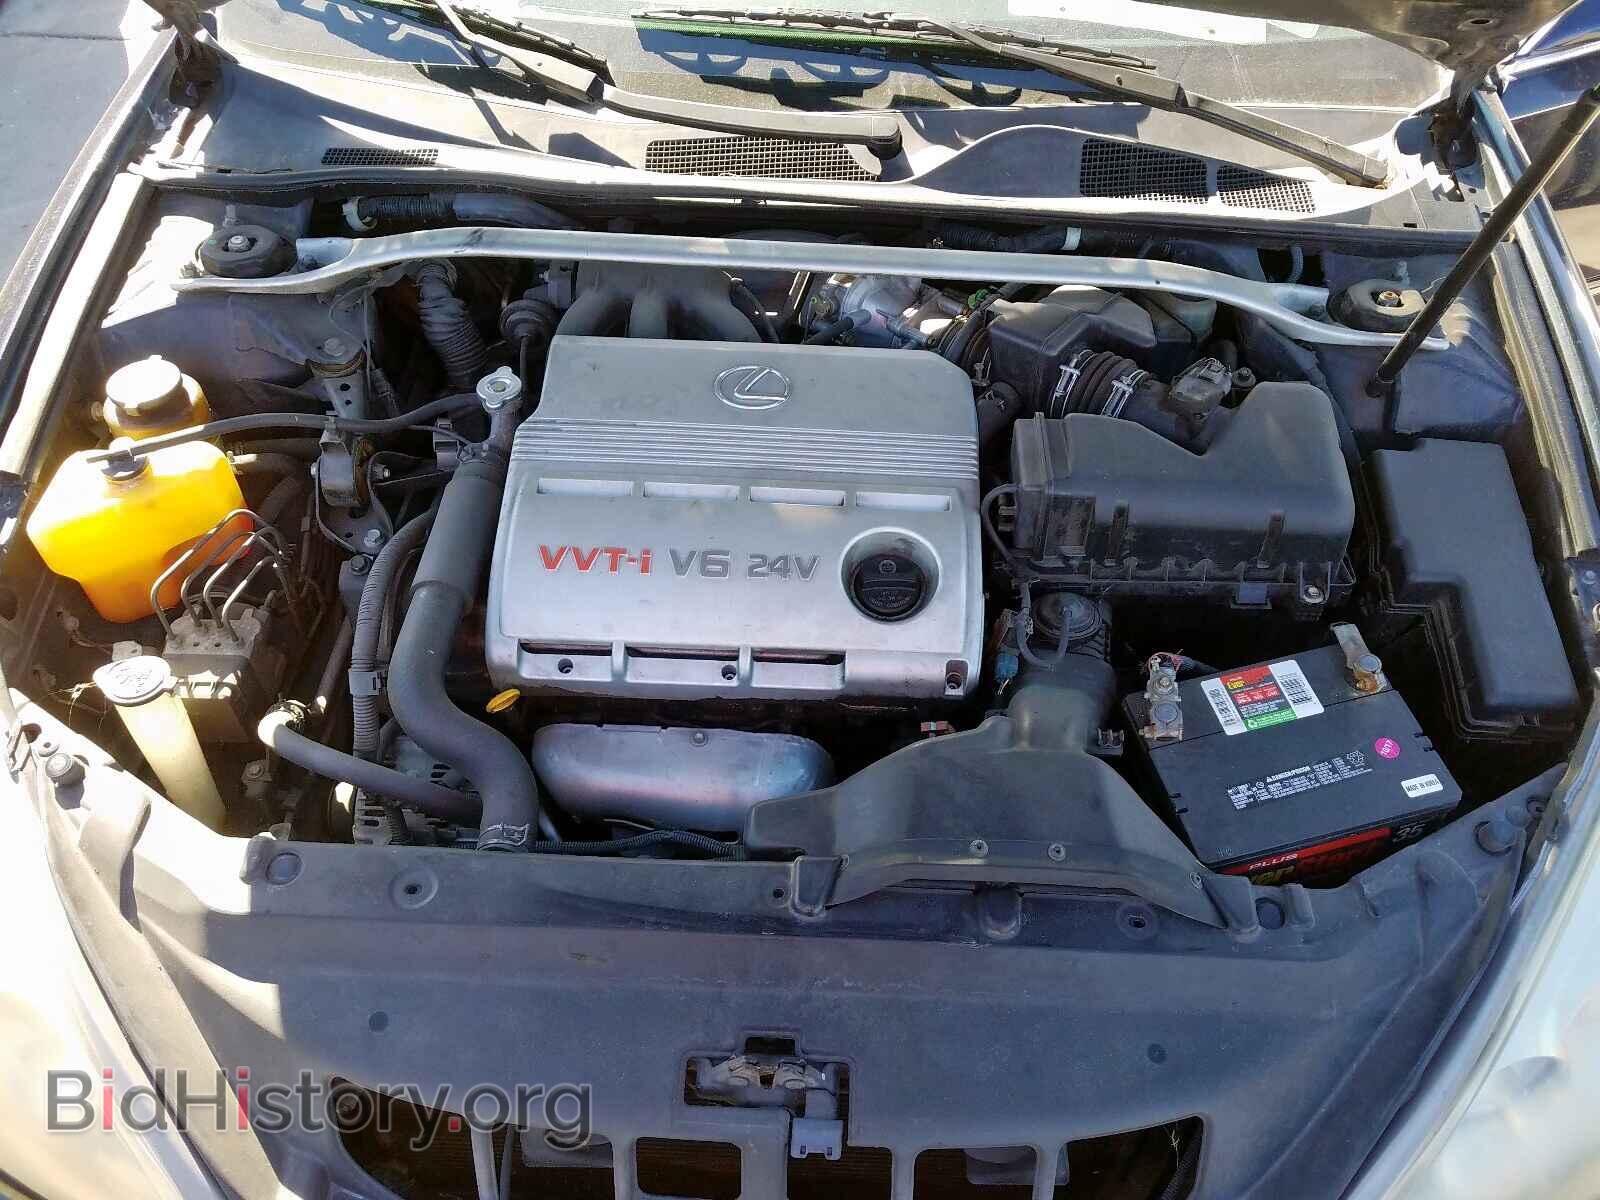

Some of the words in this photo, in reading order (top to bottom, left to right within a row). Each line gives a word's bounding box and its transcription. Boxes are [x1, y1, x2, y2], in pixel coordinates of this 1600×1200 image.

[538, 544, 652, 576] VVT-i
[669, 549, 730, 578] V6
[747, 553, 820, 582] 24V
[1248, 853, 1298, 871] PLUS
